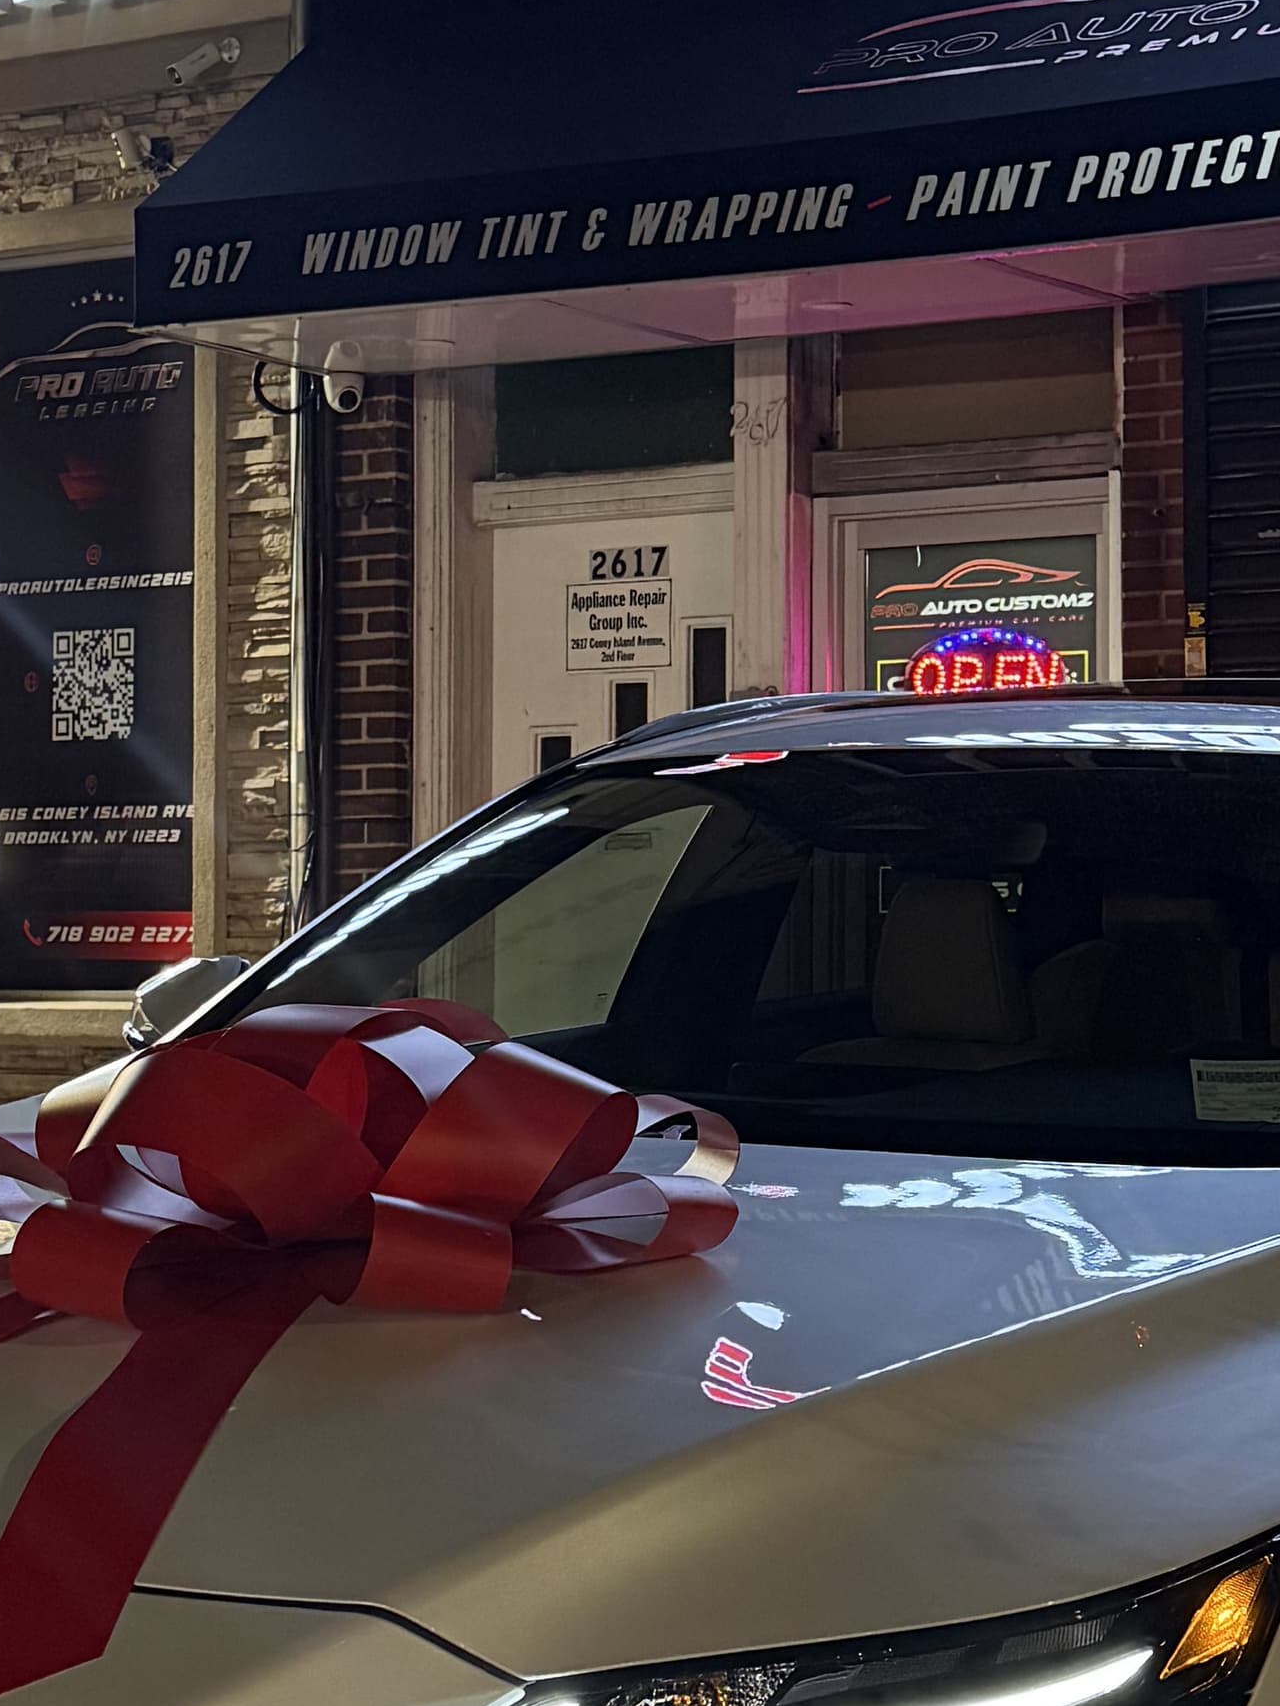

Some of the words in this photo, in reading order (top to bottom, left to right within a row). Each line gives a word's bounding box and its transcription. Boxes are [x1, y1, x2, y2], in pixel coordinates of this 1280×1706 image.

[813, 31, 998, 74] PRO
[169, 240, 253, 289] 2617
[301, 220, 463, 276] WINDOW
[477, 207, 569, 262] TINT
[581, 207, 606, 252] &
[628, 182, 854, 247] WRAPPING
[905, 160, 1052, 221] PAINT
[15, 372, 85, 402] PRO
[90, 361, 184, 395] AUTO
[39, 397, 157, 421] LEASING
[592, 547, 667, 580] 2617
[571, 591, 626, 612] Appliance
[629, 588, 667, 609] Repair
[871, 604, 919, 618] PRO
[920, 599, 982, 615] AUTO
[985, 592, 1094, 613] CUSTOMZ
[589, 614, 623, 633] Group
[627, 612, 648, 629] Inc.
[939, 619, 1003, 628] PREMIUM
[913, 653, 1059, 694] OPEN
[32, 806, 89, 820] CONEY
[94, 805, 157, 819] ISLAND
[163, 804, 194, 818] AVE
[4, 830, 98, 844] BROOKLYN,
[105, 830, 128, 843] NY
[132, 828, 181, 843] 11223
[47, 926, 83, 942] 718
[89, 926, 134, 942] 902
